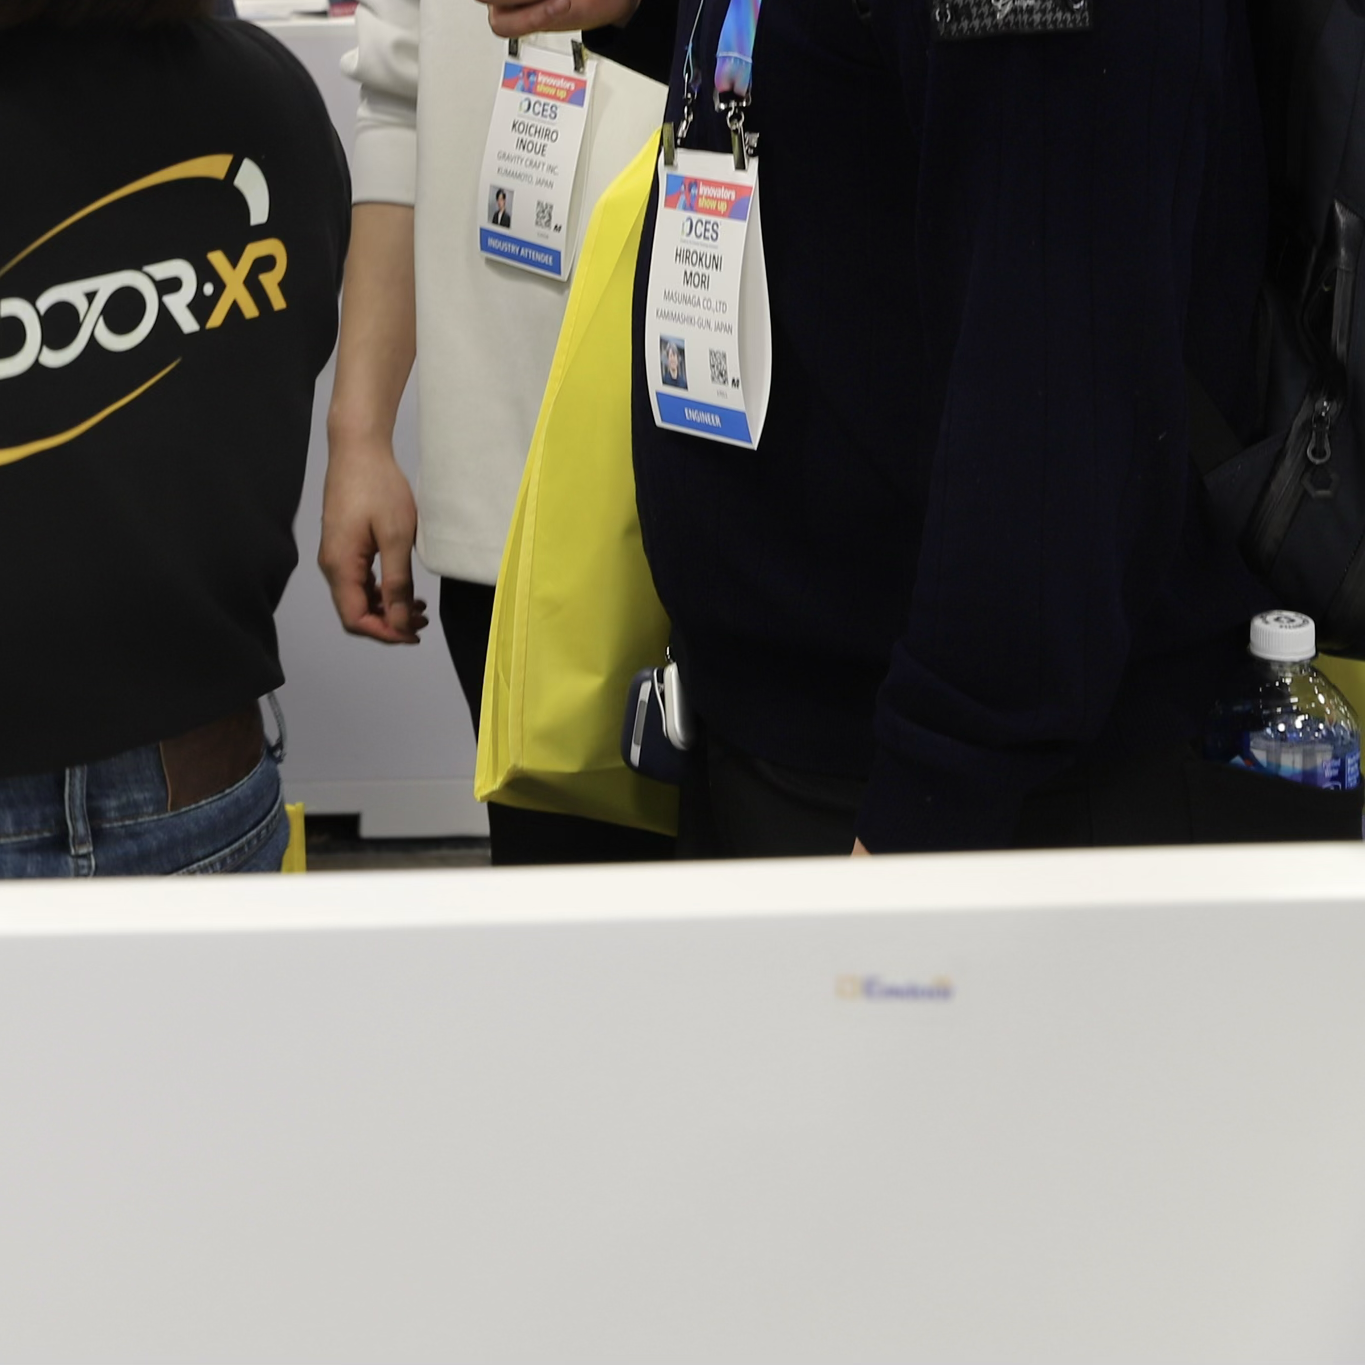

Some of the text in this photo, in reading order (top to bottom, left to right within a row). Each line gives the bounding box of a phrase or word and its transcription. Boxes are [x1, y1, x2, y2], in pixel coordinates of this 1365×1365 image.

[556, 89, 568, 100] up
[532, 97, 558, 120] CES
[511, 120, 559, 143] KOICHIRO
[516, 138, 547, 157] INOUE
[497, 151, 524, 168] GRAVITY
[524, 158, 545, 173] CRAFT
[534, 175, 554, 190] JAPAN
[697, 195, 727, 213] show up
[694, 219, 719, 241] CES
[488, 237, 553, 267] INDUSTRY ATTENDEE
[675, 246, 723, 273] HIROKUNI
[682, 269, 710, 292] MORI
[663, 288, 701, 308] MASUNAGA
[713, 319, 733, 335] JAPAN
[684, 406, 722, 429] ENGINEER
